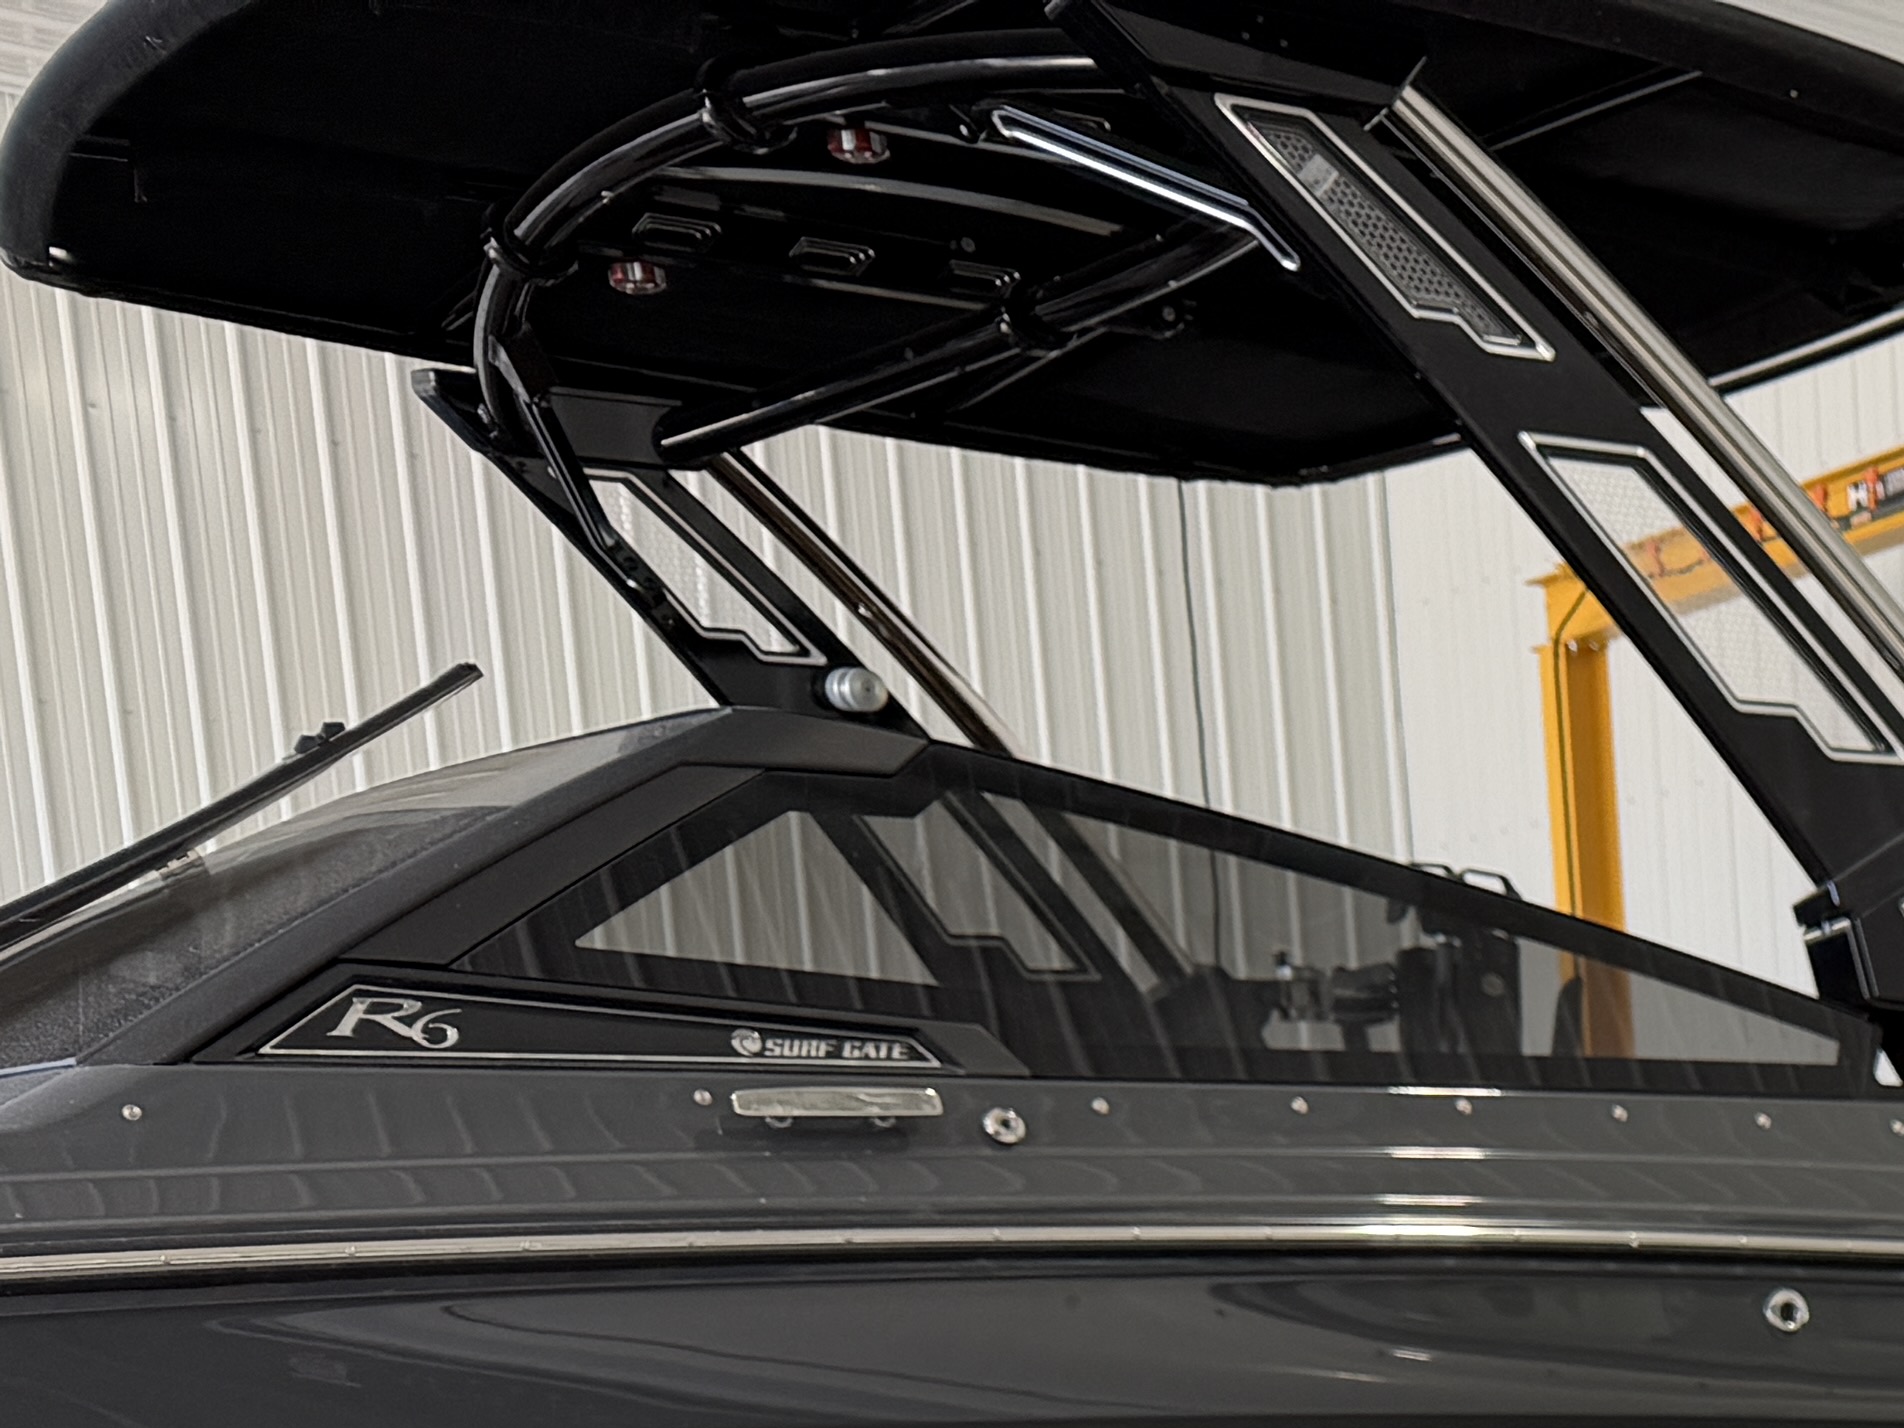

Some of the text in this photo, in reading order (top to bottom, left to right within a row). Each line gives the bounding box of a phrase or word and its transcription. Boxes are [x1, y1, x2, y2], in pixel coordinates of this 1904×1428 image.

[326, 997, 460, 1050] R6
[763, 1037, 910, 1061] SURF GATE
